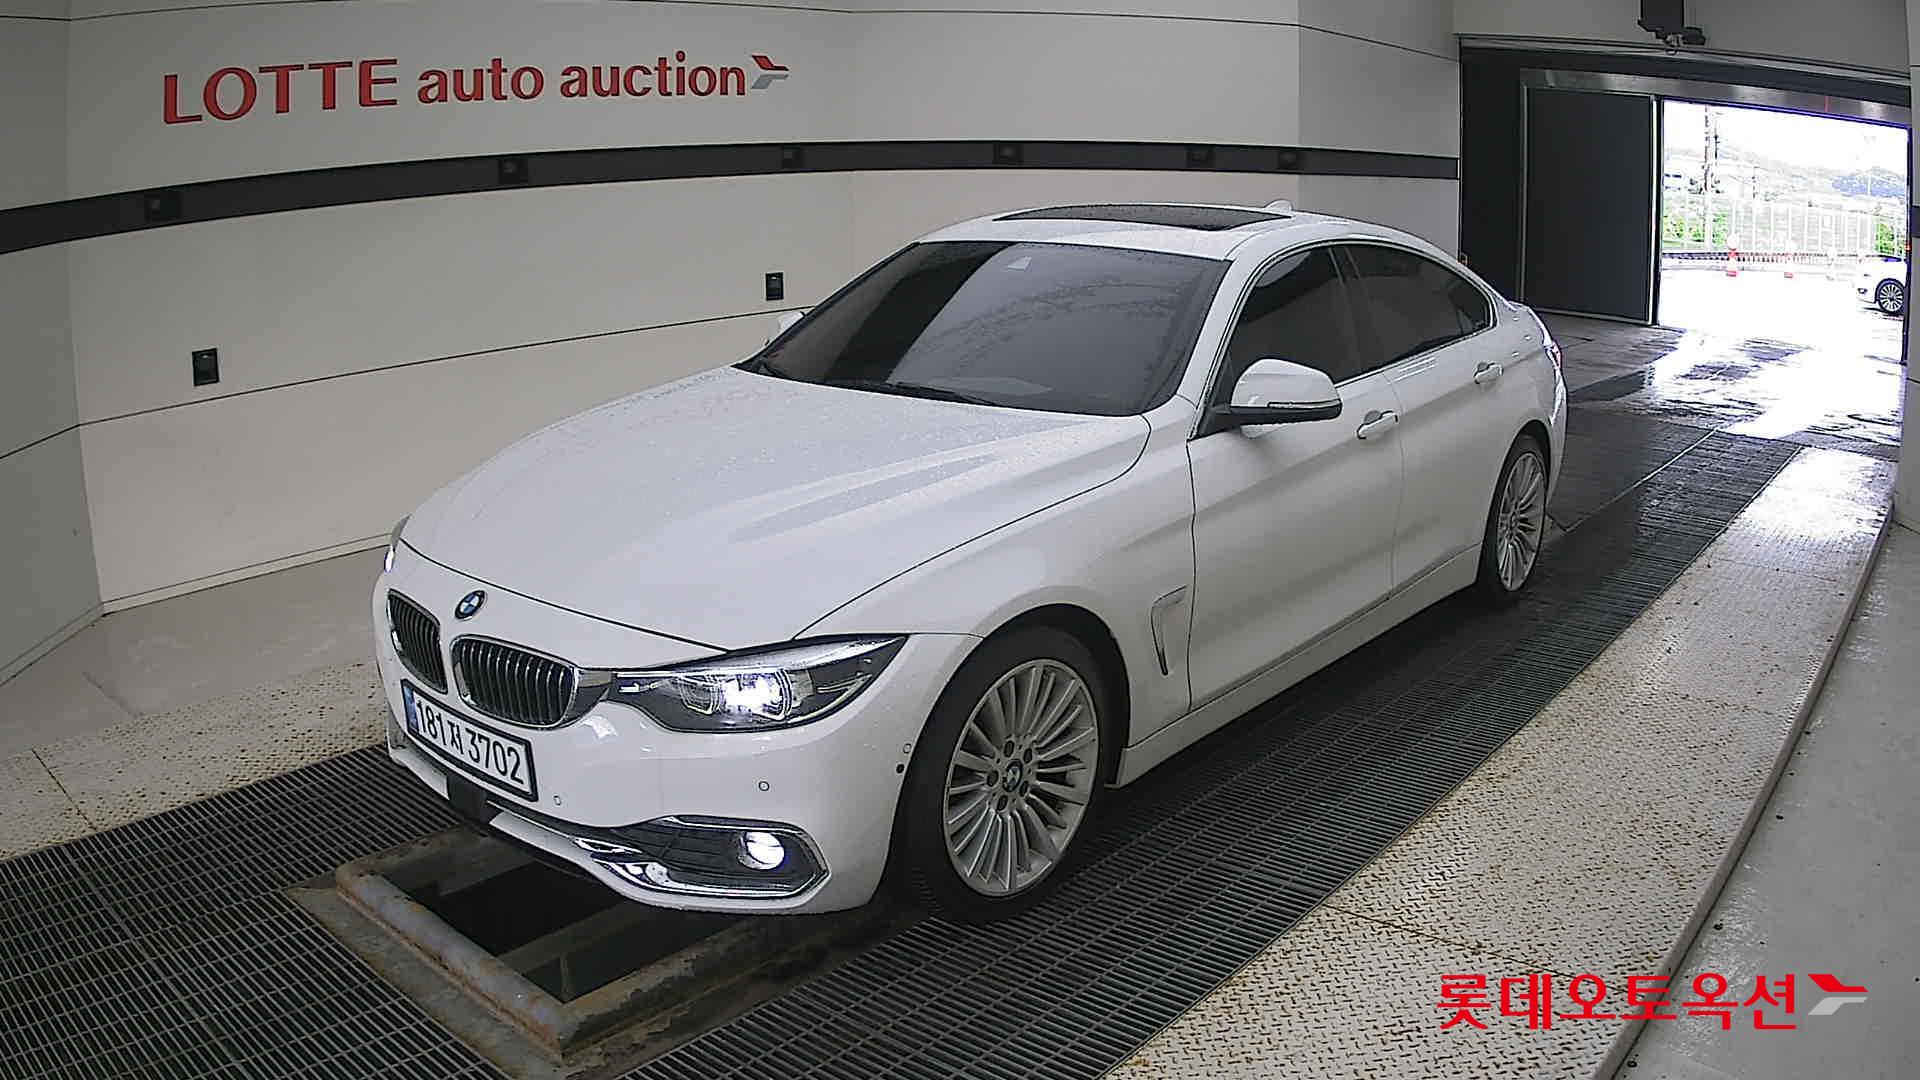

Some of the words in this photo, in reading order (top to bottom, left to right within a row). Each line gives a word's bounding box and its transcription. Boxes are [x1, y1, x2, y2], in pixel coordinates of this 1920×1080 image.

[163, 59, 399, 125] LOTTE
[416, 58, 545, 104] auto
[559, 50, 746, 99] auction
[465, 727, 525, 786] 3702
